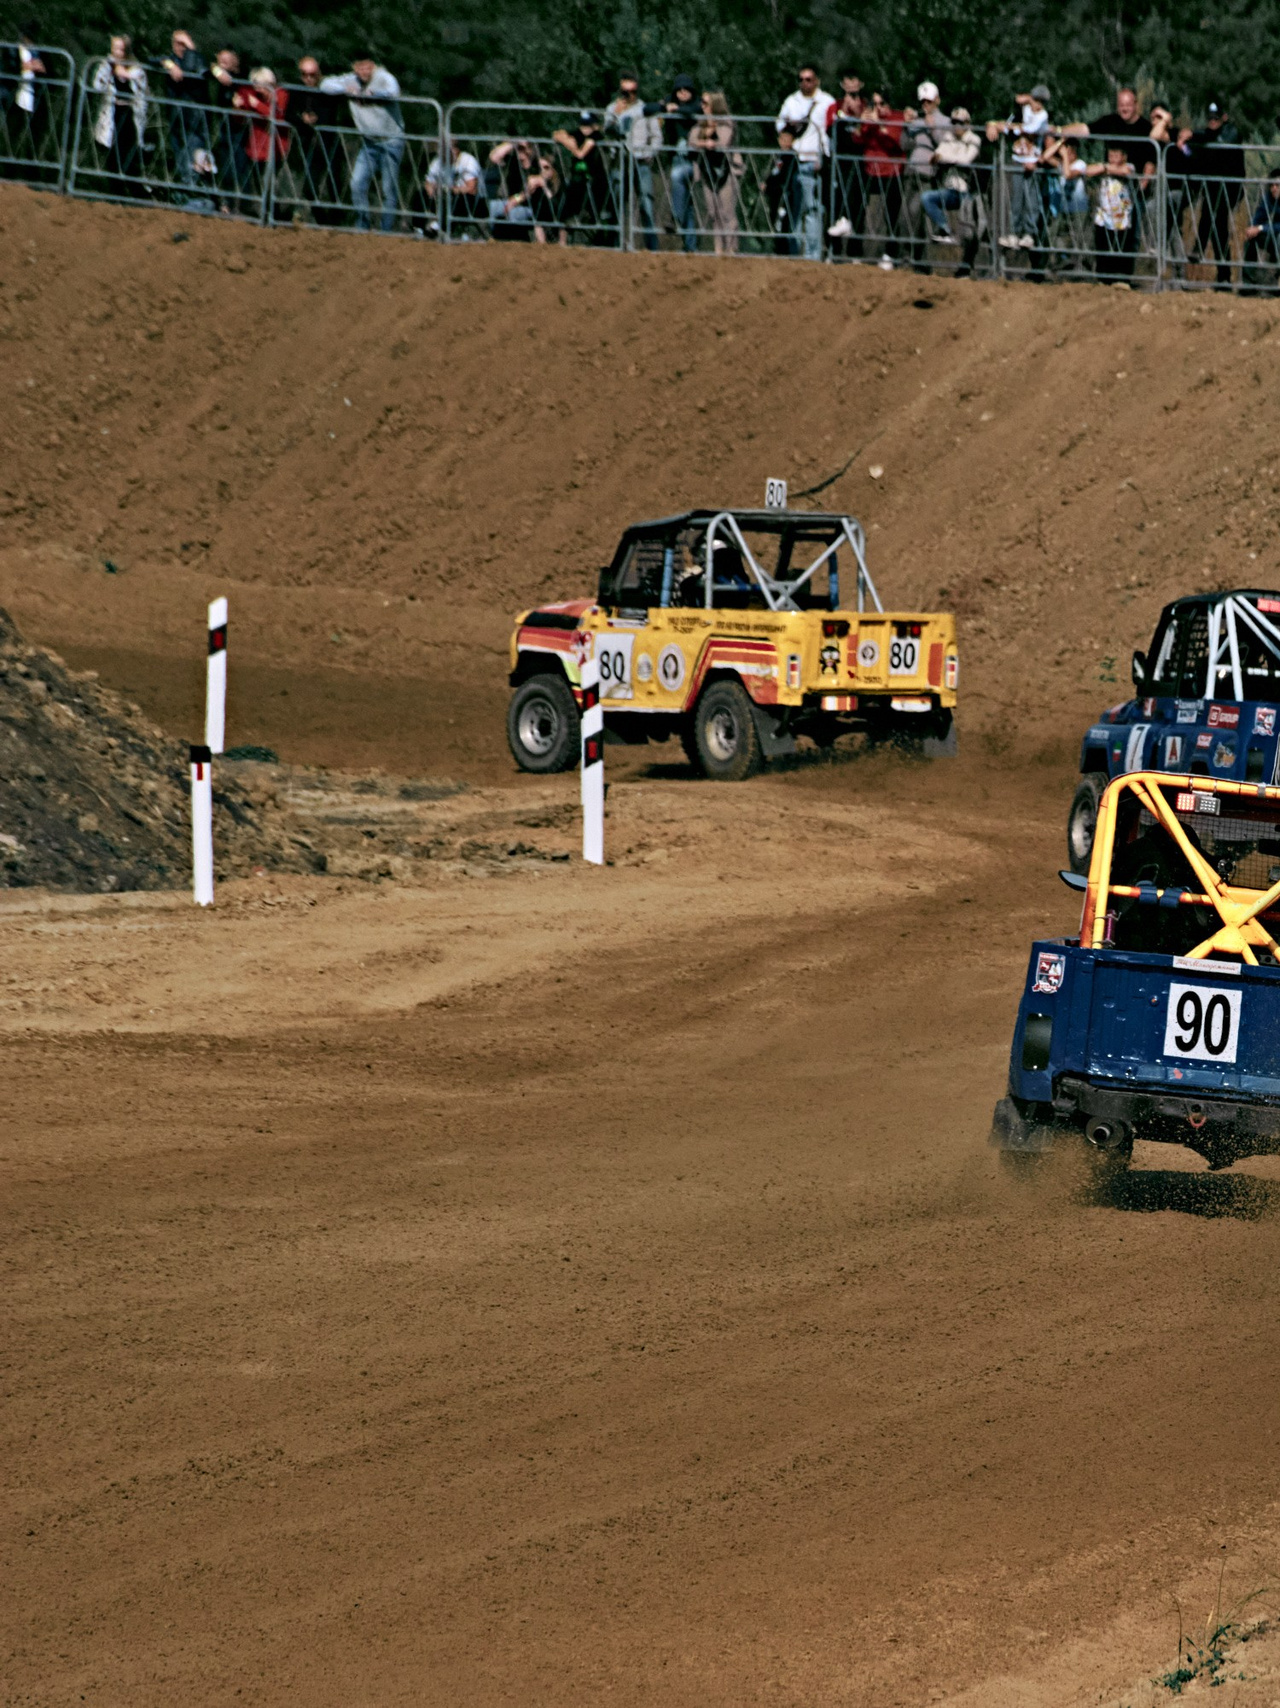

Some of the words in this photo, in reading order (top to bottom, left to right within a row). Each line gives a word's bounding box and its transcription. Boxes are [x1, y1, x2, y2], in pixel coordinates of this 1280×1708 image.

[767, 482, 782, 506] 80
[890, 642, 915, 669] 80
[1175, 990, 1231, 1055] 90
